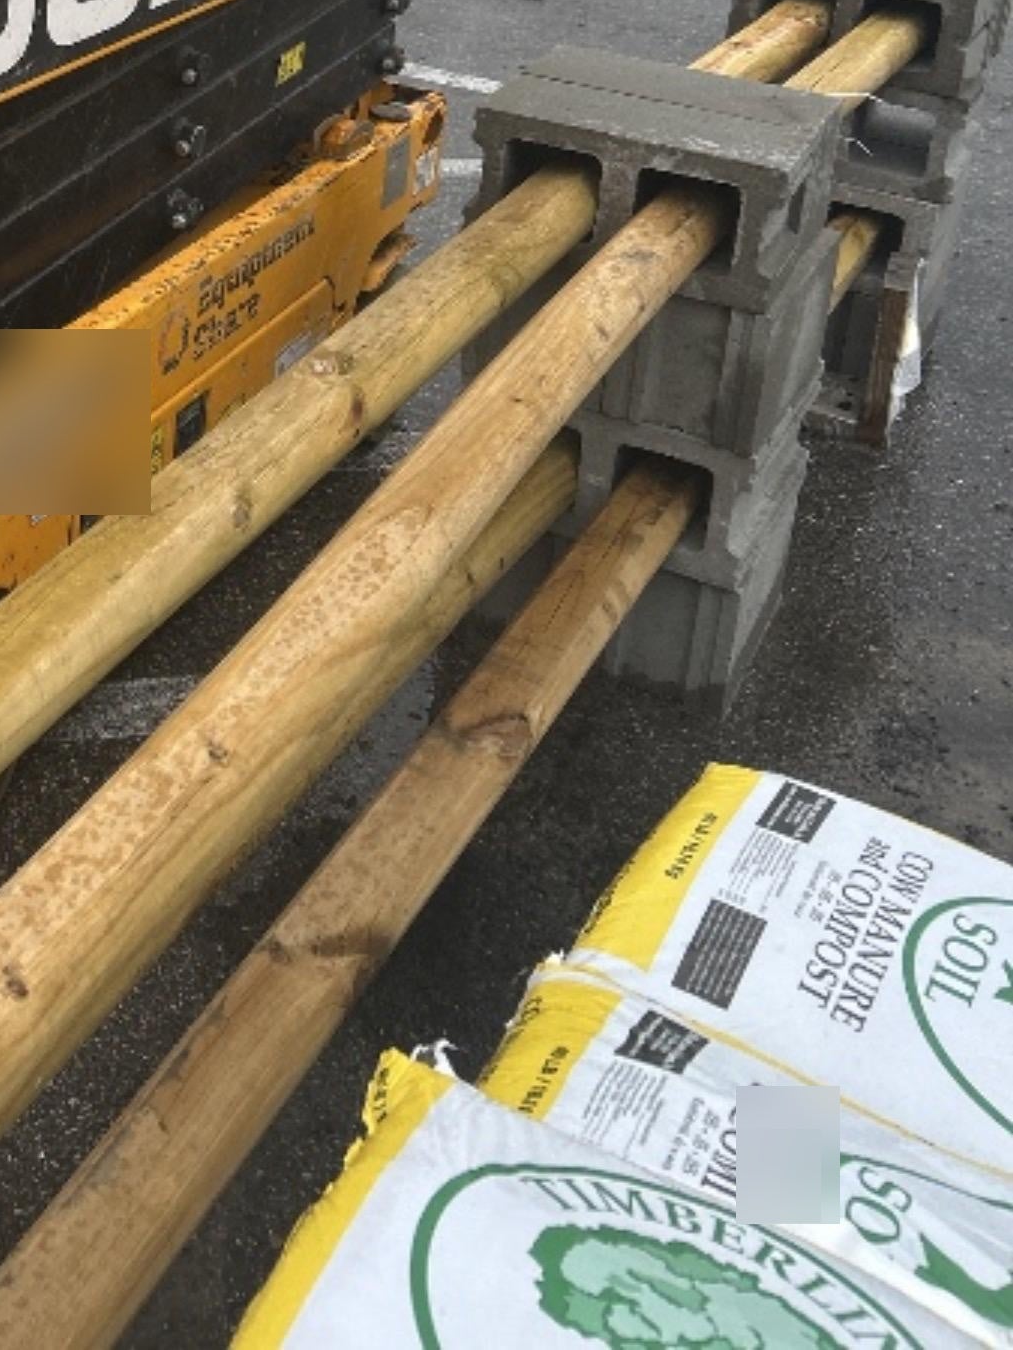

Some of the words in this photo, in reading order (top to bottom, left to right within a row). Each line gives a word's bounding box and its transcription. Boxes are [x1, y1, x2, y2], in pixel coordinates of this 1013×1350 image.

[197, 214, 315, 318] Equipment
[859, 836, 892, 874] and
[888, 850, 935, 904] COW
[797, 868, 882, 1009] COMPOST
[829, 888, 912, 1033] MANURE
[924, 913, 998, 1008] SOIL
